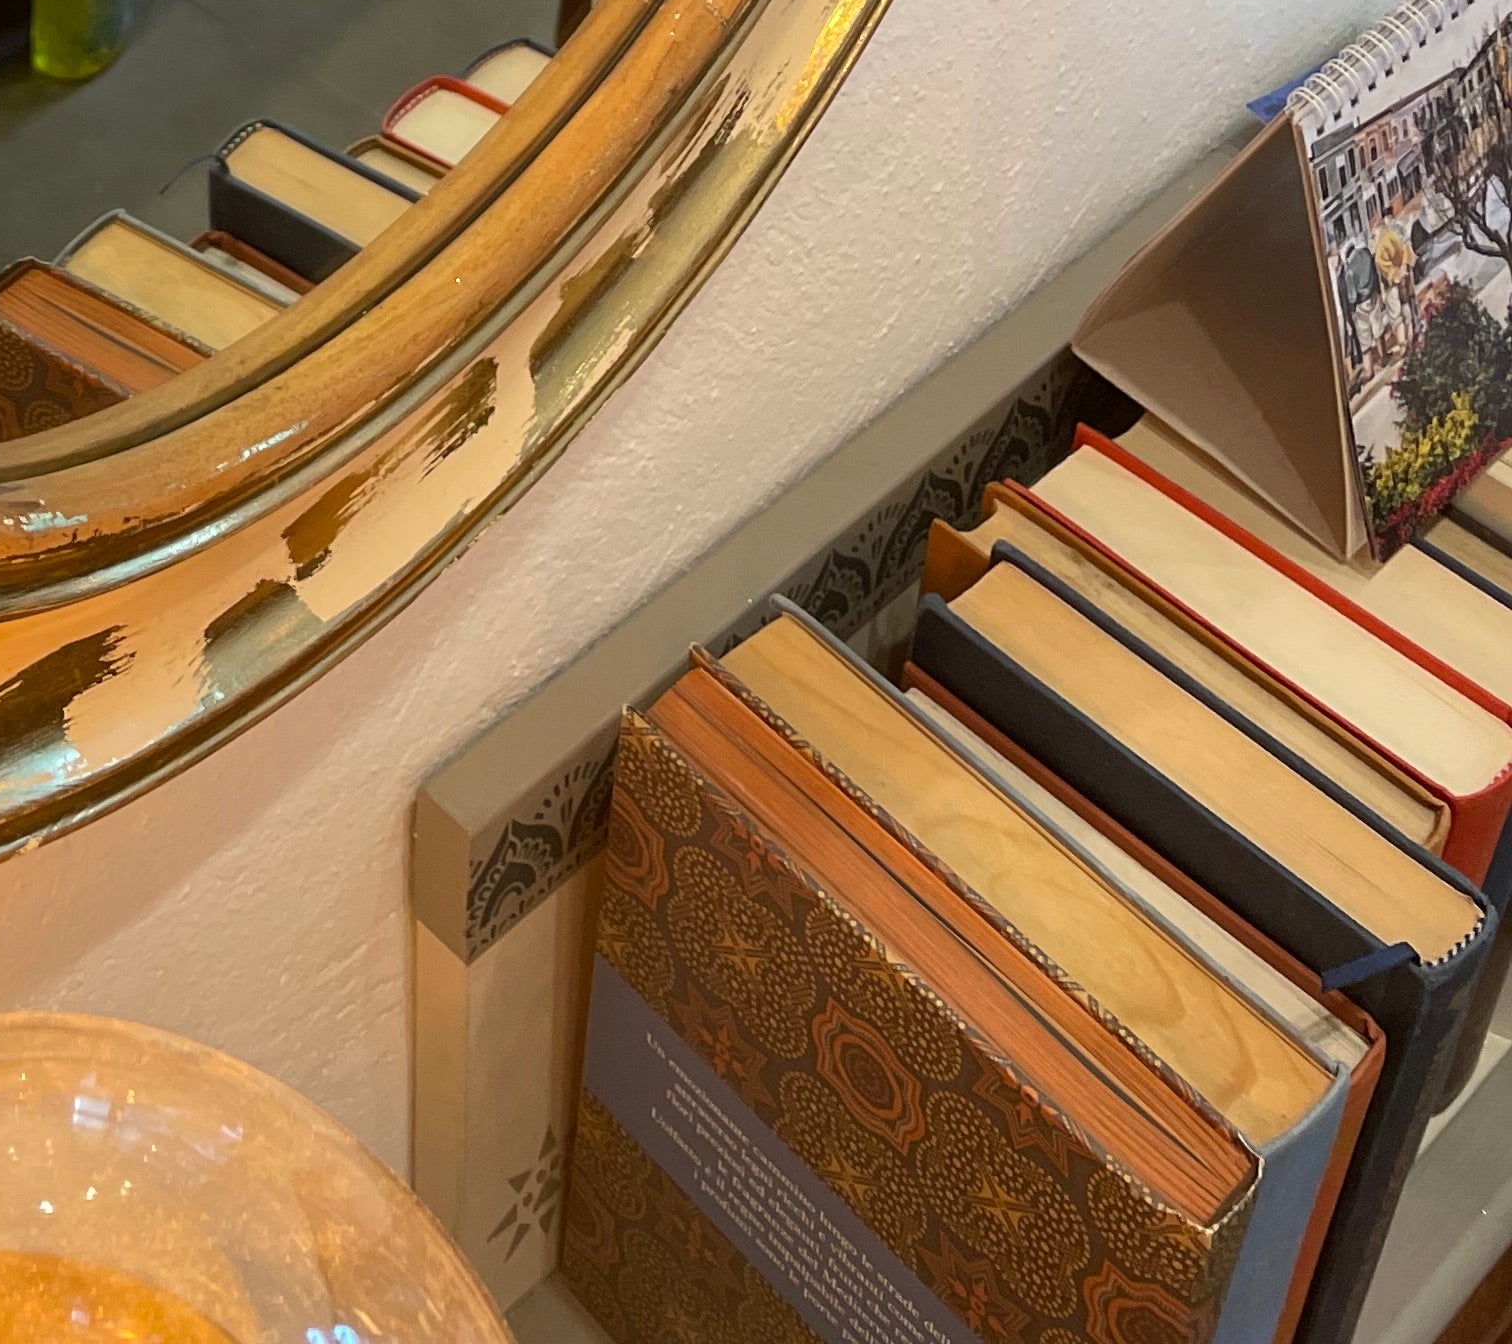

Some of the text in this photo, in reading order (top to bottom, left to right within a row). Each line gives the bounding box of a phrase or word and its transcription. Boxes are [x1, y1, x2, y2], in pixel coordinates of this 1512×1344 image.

[646, 1031, 666, 1060] Un
[668, 1059, 750, 1146] emozionante
[752, 1145, 817, 1214] cammino
[819, 1210, 858, 1257] lungo
[861, 1253, 874, 1272] le
[877, 1272, 920, 1319] strade
[716, 1175, 726, 1192] il
[727, 1191, 765, 1233] regno
[768, 1231, 846, 1316] impalpabile
[717, 1159, 729, 1177] le
[731, 1175, 794, 1246] fragranze
[797, 1246, 819, 1271] del
[740, 1148, 773, 1189] legni
[776, 1188, 816, 1231] ricchi
[818, 1231, 826, 1242] e
[830, 1242, 884, 1302] vibranti
[887, 1302, 925, 1343] come
[748, 1177, 766, 1199] ed
[828, 1257, 863, 1299] frutti
[866, 1299, 891, 1327] che
[894, 1327, 913, 1344] re
[755, 1237, 786, 1271] sono
[788, 1268, 800, 1285] le
[803, 1287, 839, 1326] porte
